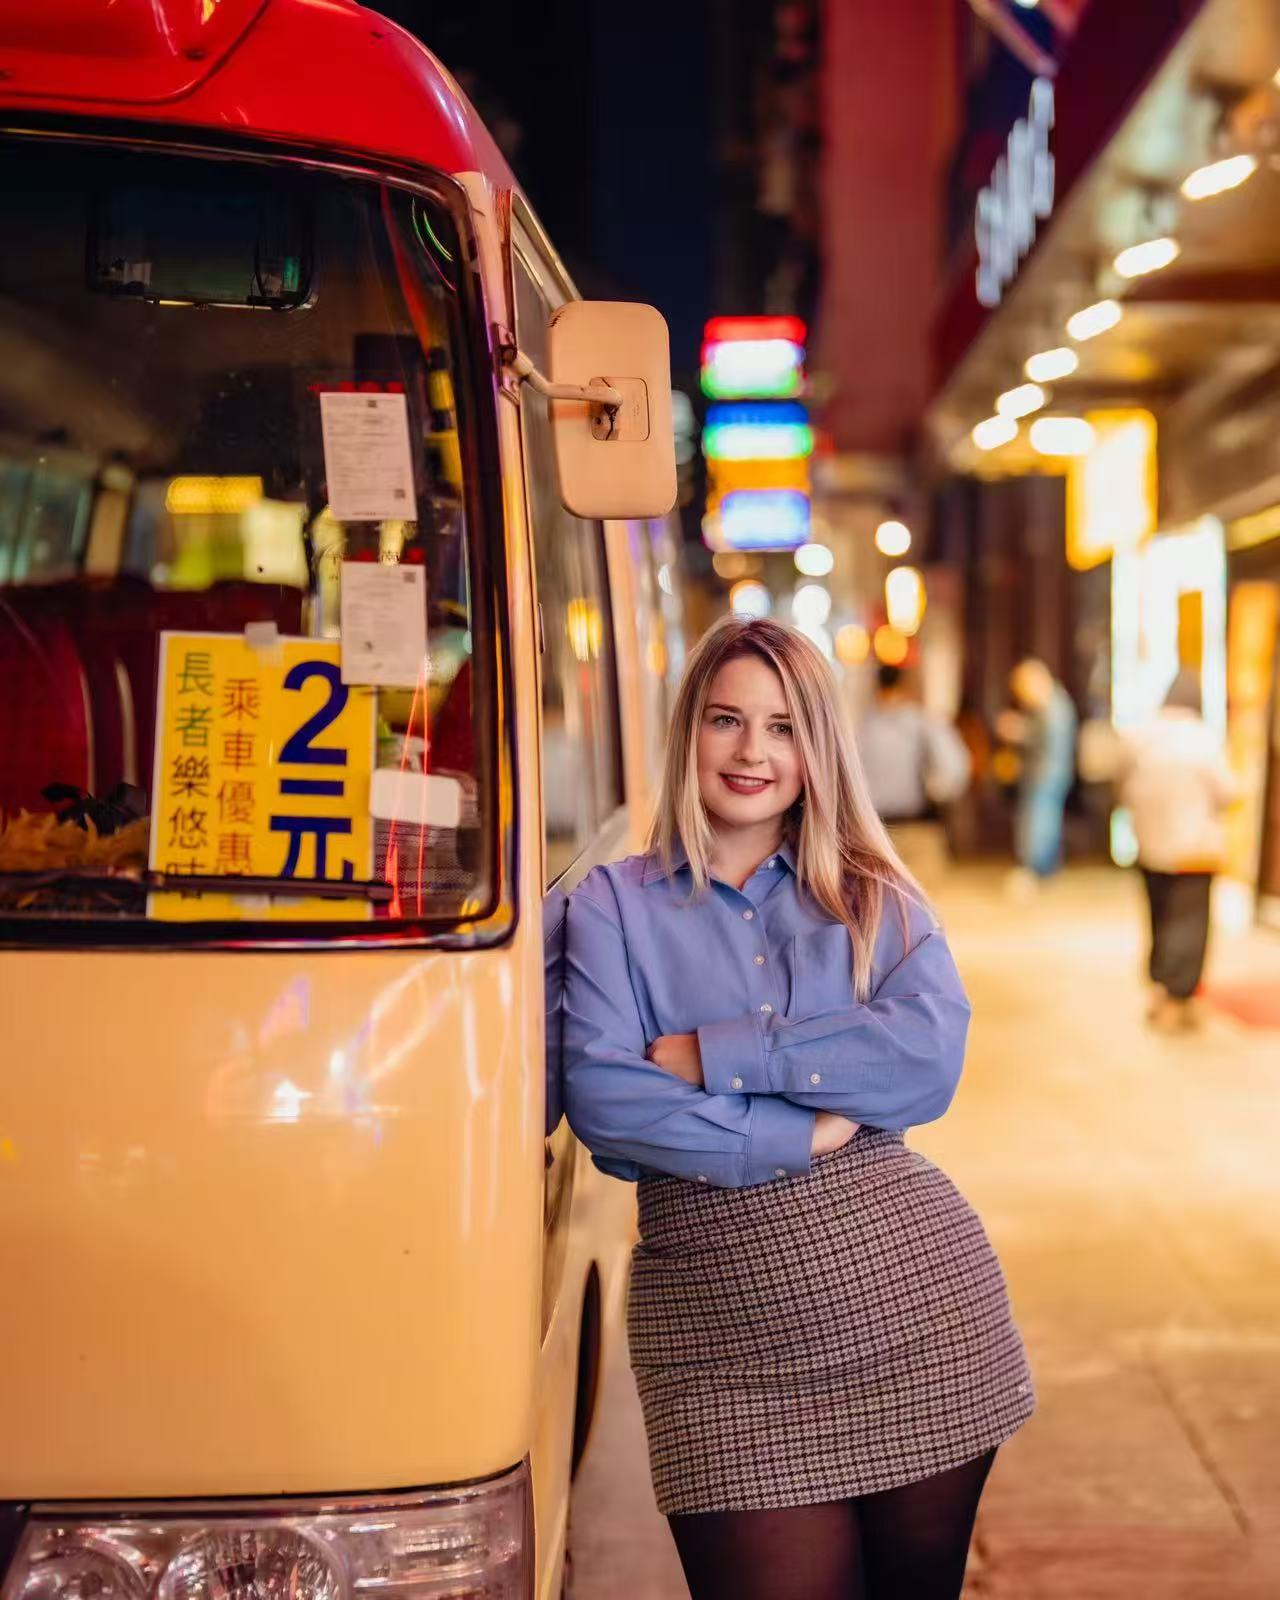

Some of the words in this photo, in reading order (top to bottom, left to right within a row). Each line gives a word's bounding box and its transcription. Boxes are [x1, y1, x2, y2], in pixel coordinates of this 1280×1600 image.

[215, 677, 262, 876] 乘車優惠
[269, 660, 354, 903] 2元
